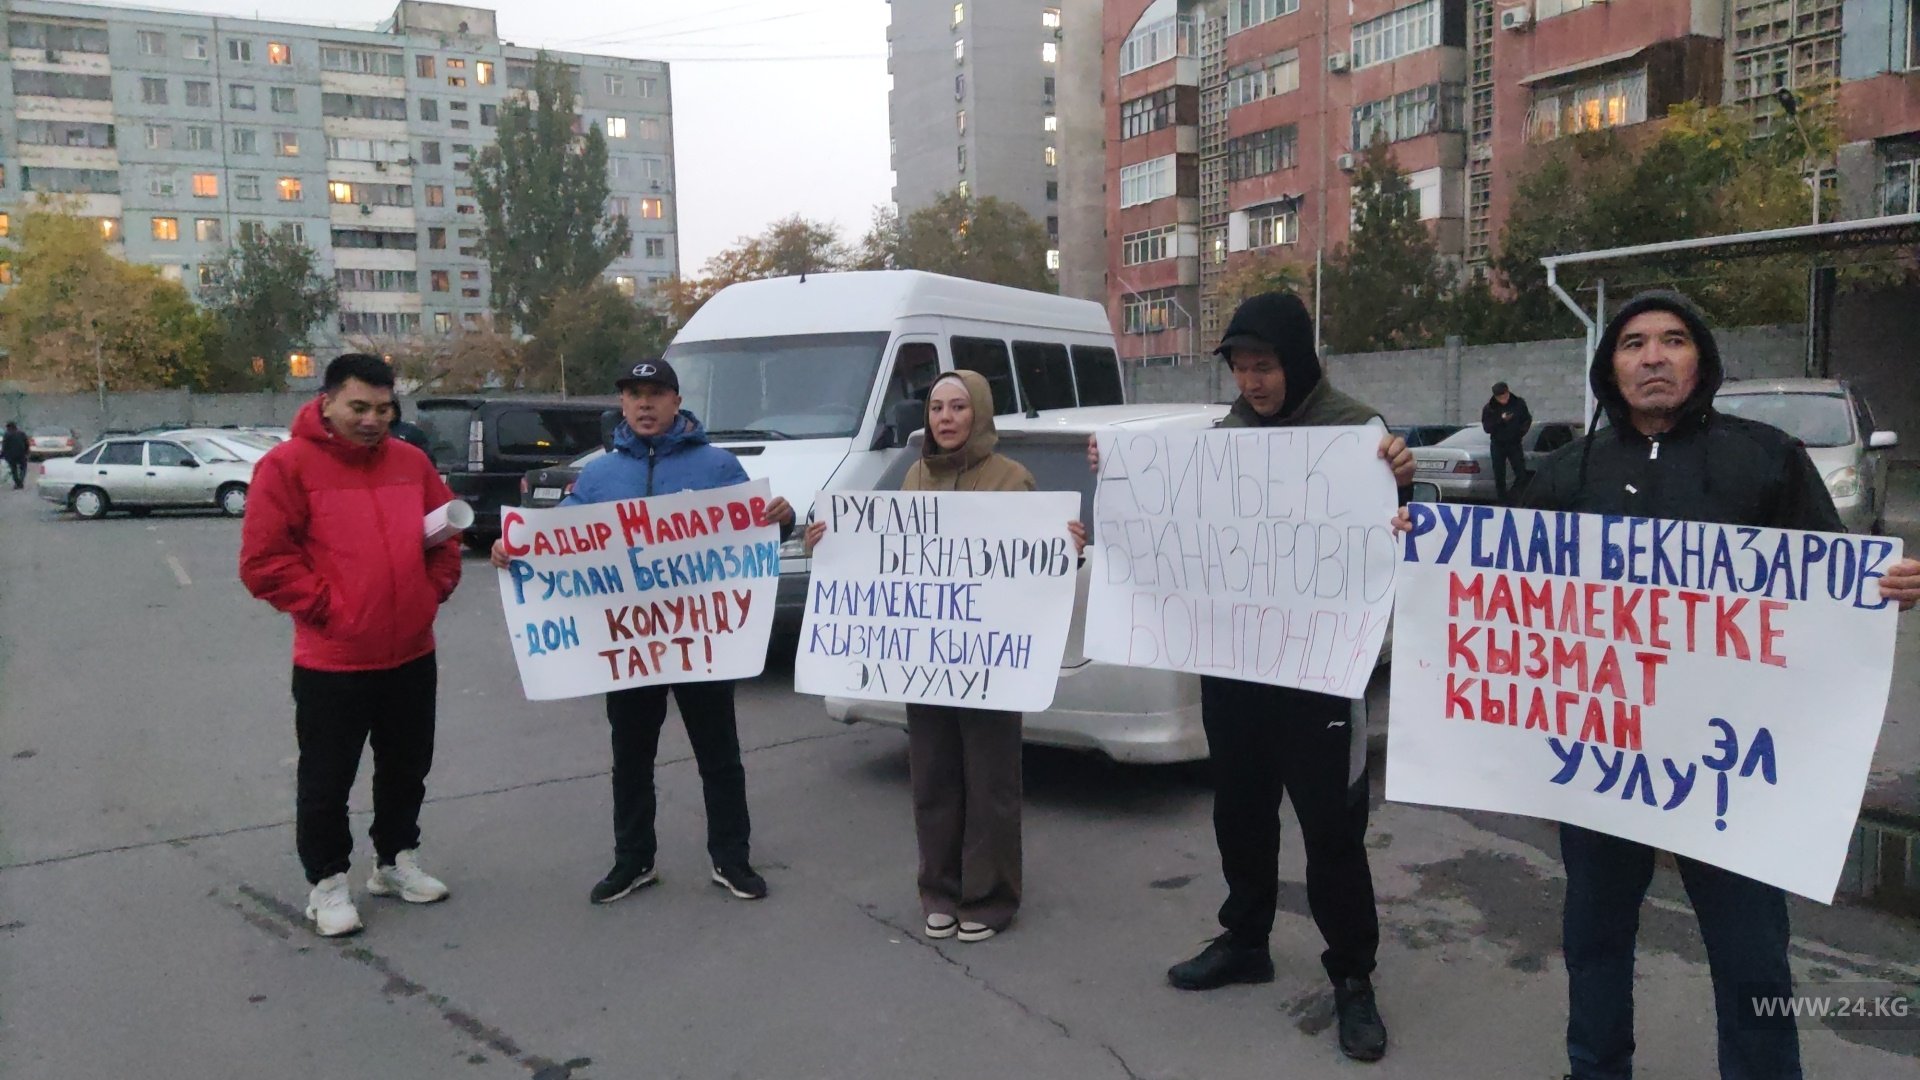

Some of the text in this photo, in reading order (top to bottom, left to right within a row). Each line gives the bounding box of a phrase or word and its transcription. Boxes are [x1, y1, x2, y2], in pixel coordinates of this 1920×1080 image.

[1100, 431, 1359, 520] АЗИМБЕК
[503, 496, 770, 557] САДЫР ЖАПАРОВ
[831, 494, 939, 535] РУСЛАН
[508, 559, 624, 605] РУСЛАН
[879, 533, 1070, 579] БЕКНАЗАРОВ
[1403, 503, 1893, 610] РУСЛАН БЕКНАЗАРОВ
[604, 588, 752, 642] КОЛУНДУ
[814, 580, 982, 622] МАМЛЕКЕТКЕ
[1448, 571, 1789, 668] МАМЛЕКЕТКЕ
[598, 634, 713, 681] ТАРТ!
[809, 623, 1032, 669] КЫЗМАТ КЫЛГАН
[1128, 592, 1387, 697] БОШТОНДУК
[1447, 622, 1668, 706] КЫЗМАТ
[846, 661, 990, 700] ЭЛ УУЛУ!
[1445, 672, 1643, 751] КЫЛГАН
[1702, 717, 1777, 785] ЭЛ
